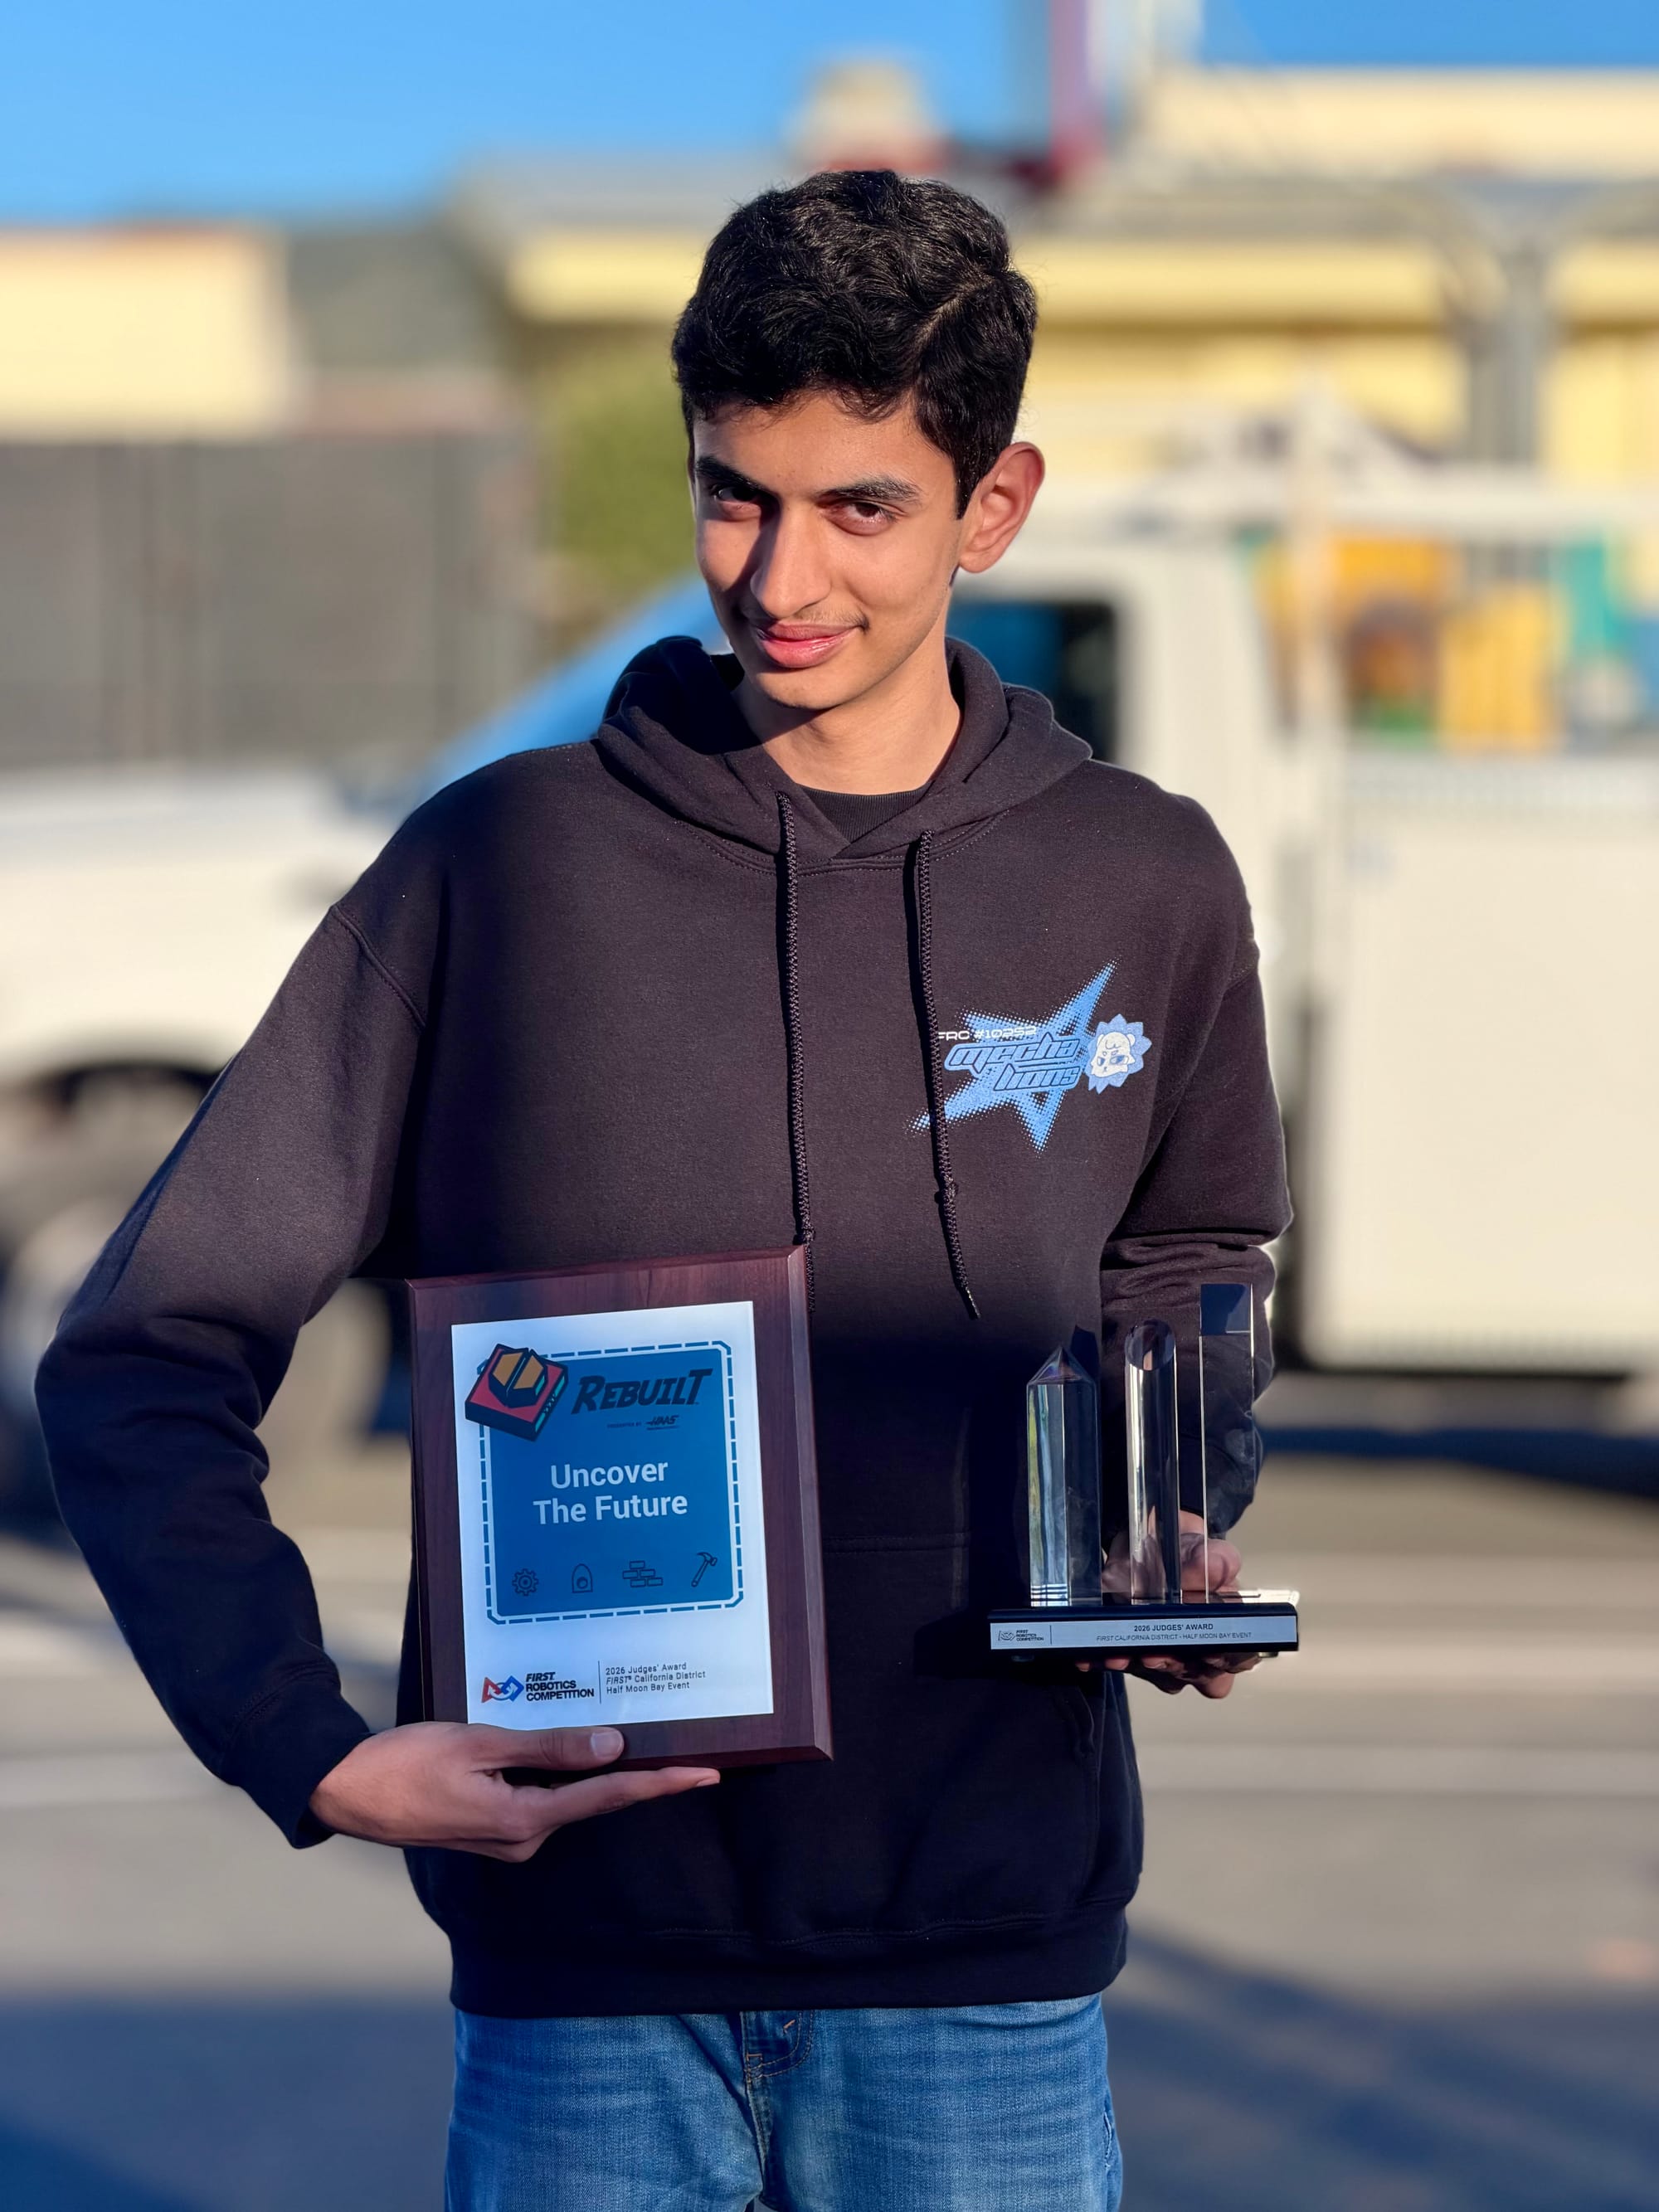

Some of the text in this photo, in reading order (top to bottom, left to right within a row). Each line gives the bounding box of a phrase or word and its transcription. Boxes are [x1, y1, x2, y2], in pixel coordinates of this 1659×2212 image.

[974, 1025, 1037, 1039] #10252
[571, 1369, 713, 1415] REBUILT
[550, 1461, 669, 1489] Uncover
[533, 1495, 688, 1524] The Future
[606, 1666, 625, 1675] 2026
[662, 1662, 687, 1672] Award
[526, 1671, 556, 1682] FIRST
[635, 1673, 674, 1683] California
[676, 1670, 706, 1680] District
[526, 1680, 577, 1692] ROBOTICS
[606, 1681, 690, 1694] Half Moon Bay Event
[526, 1688, 595, 1701] COMPETITION
